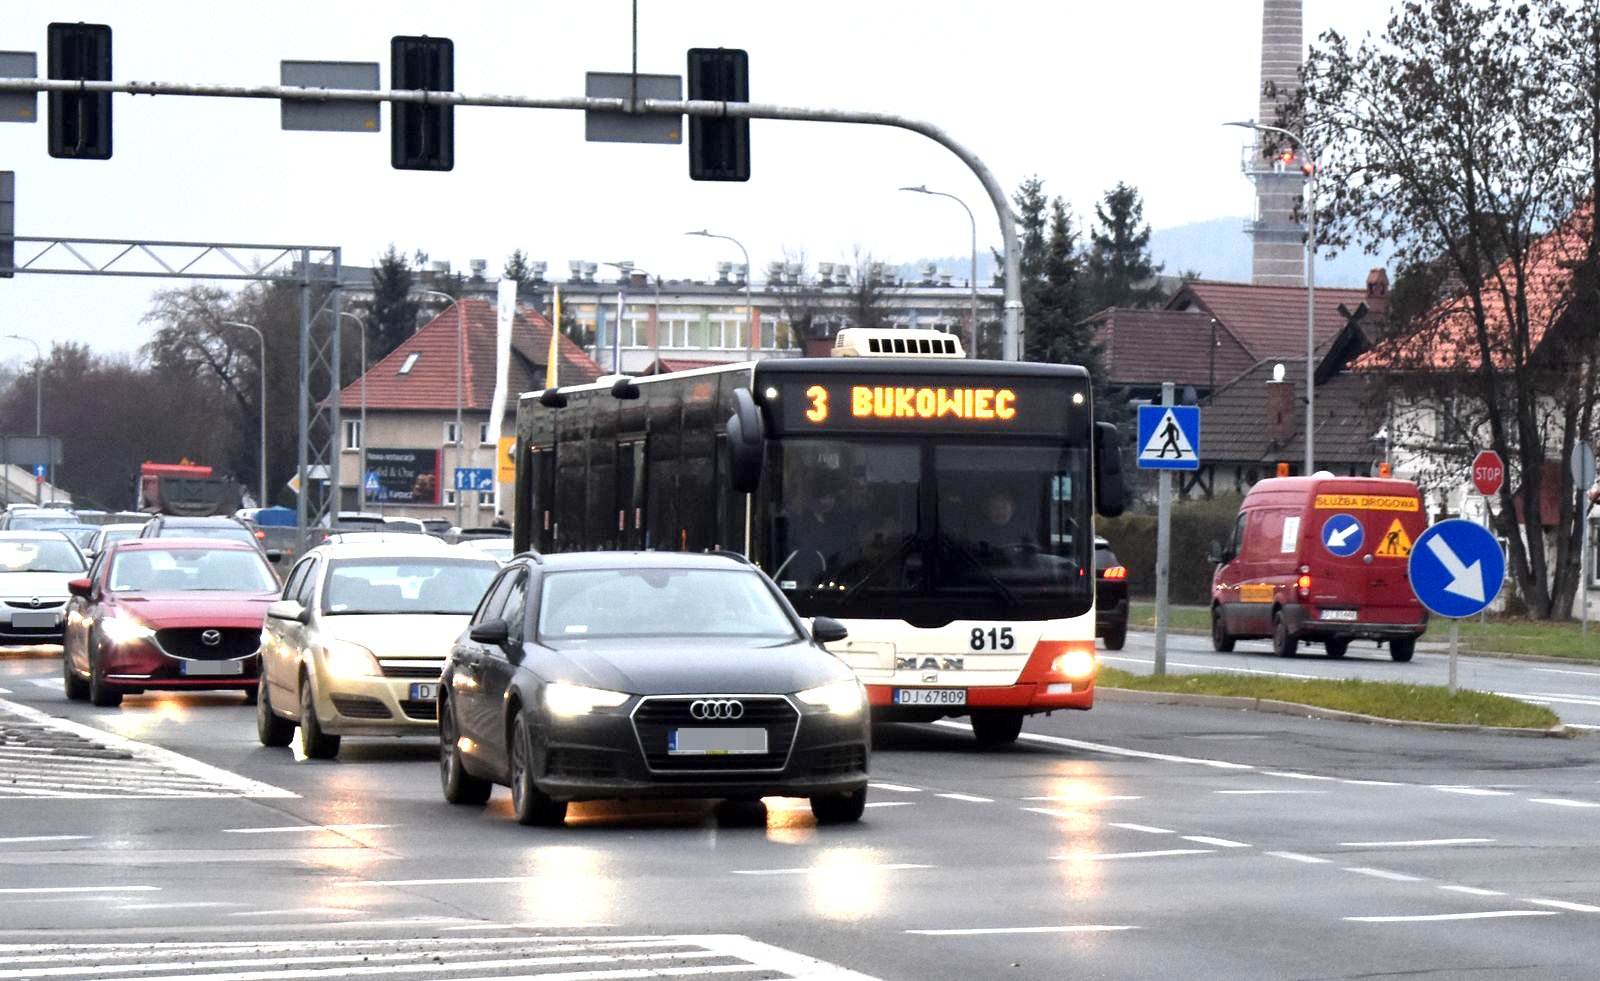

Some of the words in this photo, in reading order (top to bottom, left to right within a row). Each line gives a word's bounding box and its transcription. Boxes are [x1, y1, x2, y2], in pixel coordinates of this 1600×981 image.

[806, 385, 829, 422] 3
[853, 386, 1016, 420] BUKOWIEC
[1476, 467, 1501, 481] STOP
[1361, 498, 1416, 509] DROGOWA
[970, 627, 1014, 650] 815
[896, 657, 964, 670] MAN
